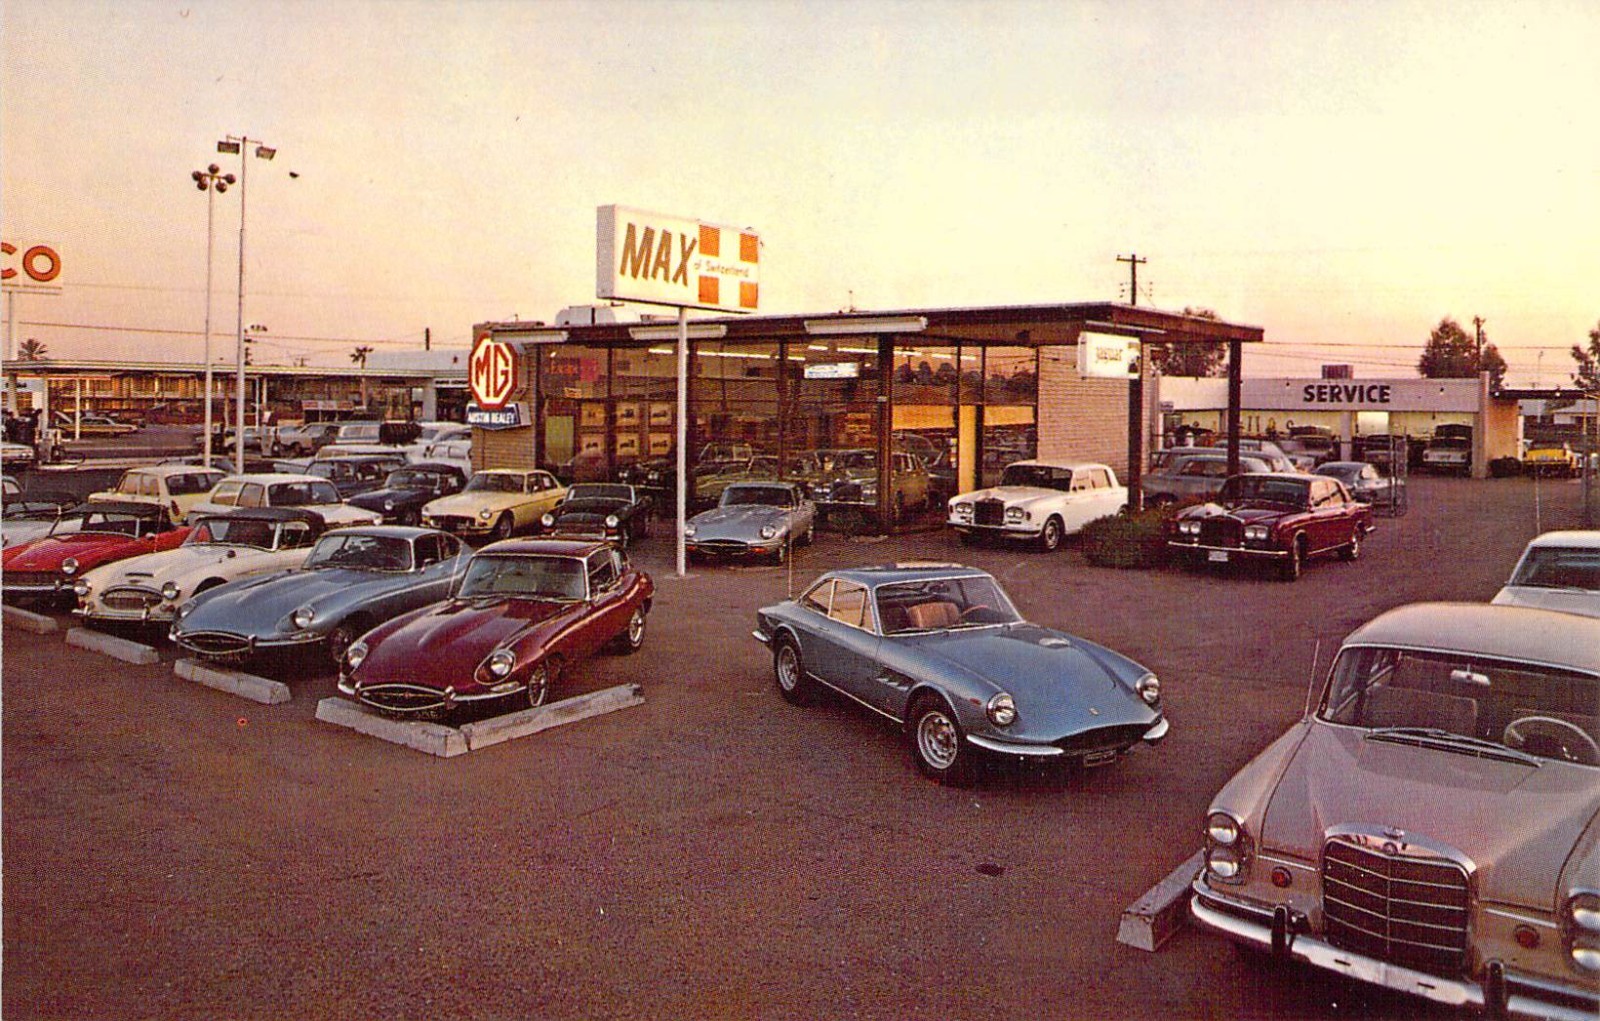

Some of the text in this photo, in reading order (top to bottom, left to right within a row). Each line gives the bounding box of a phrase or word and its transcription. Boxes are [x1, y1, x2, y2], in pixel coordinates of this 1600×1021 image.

[619, 222, 697, 287] MAX
[475, 344, 510, 398] MG
[1303, 384, 1391, 403] SERVICE
